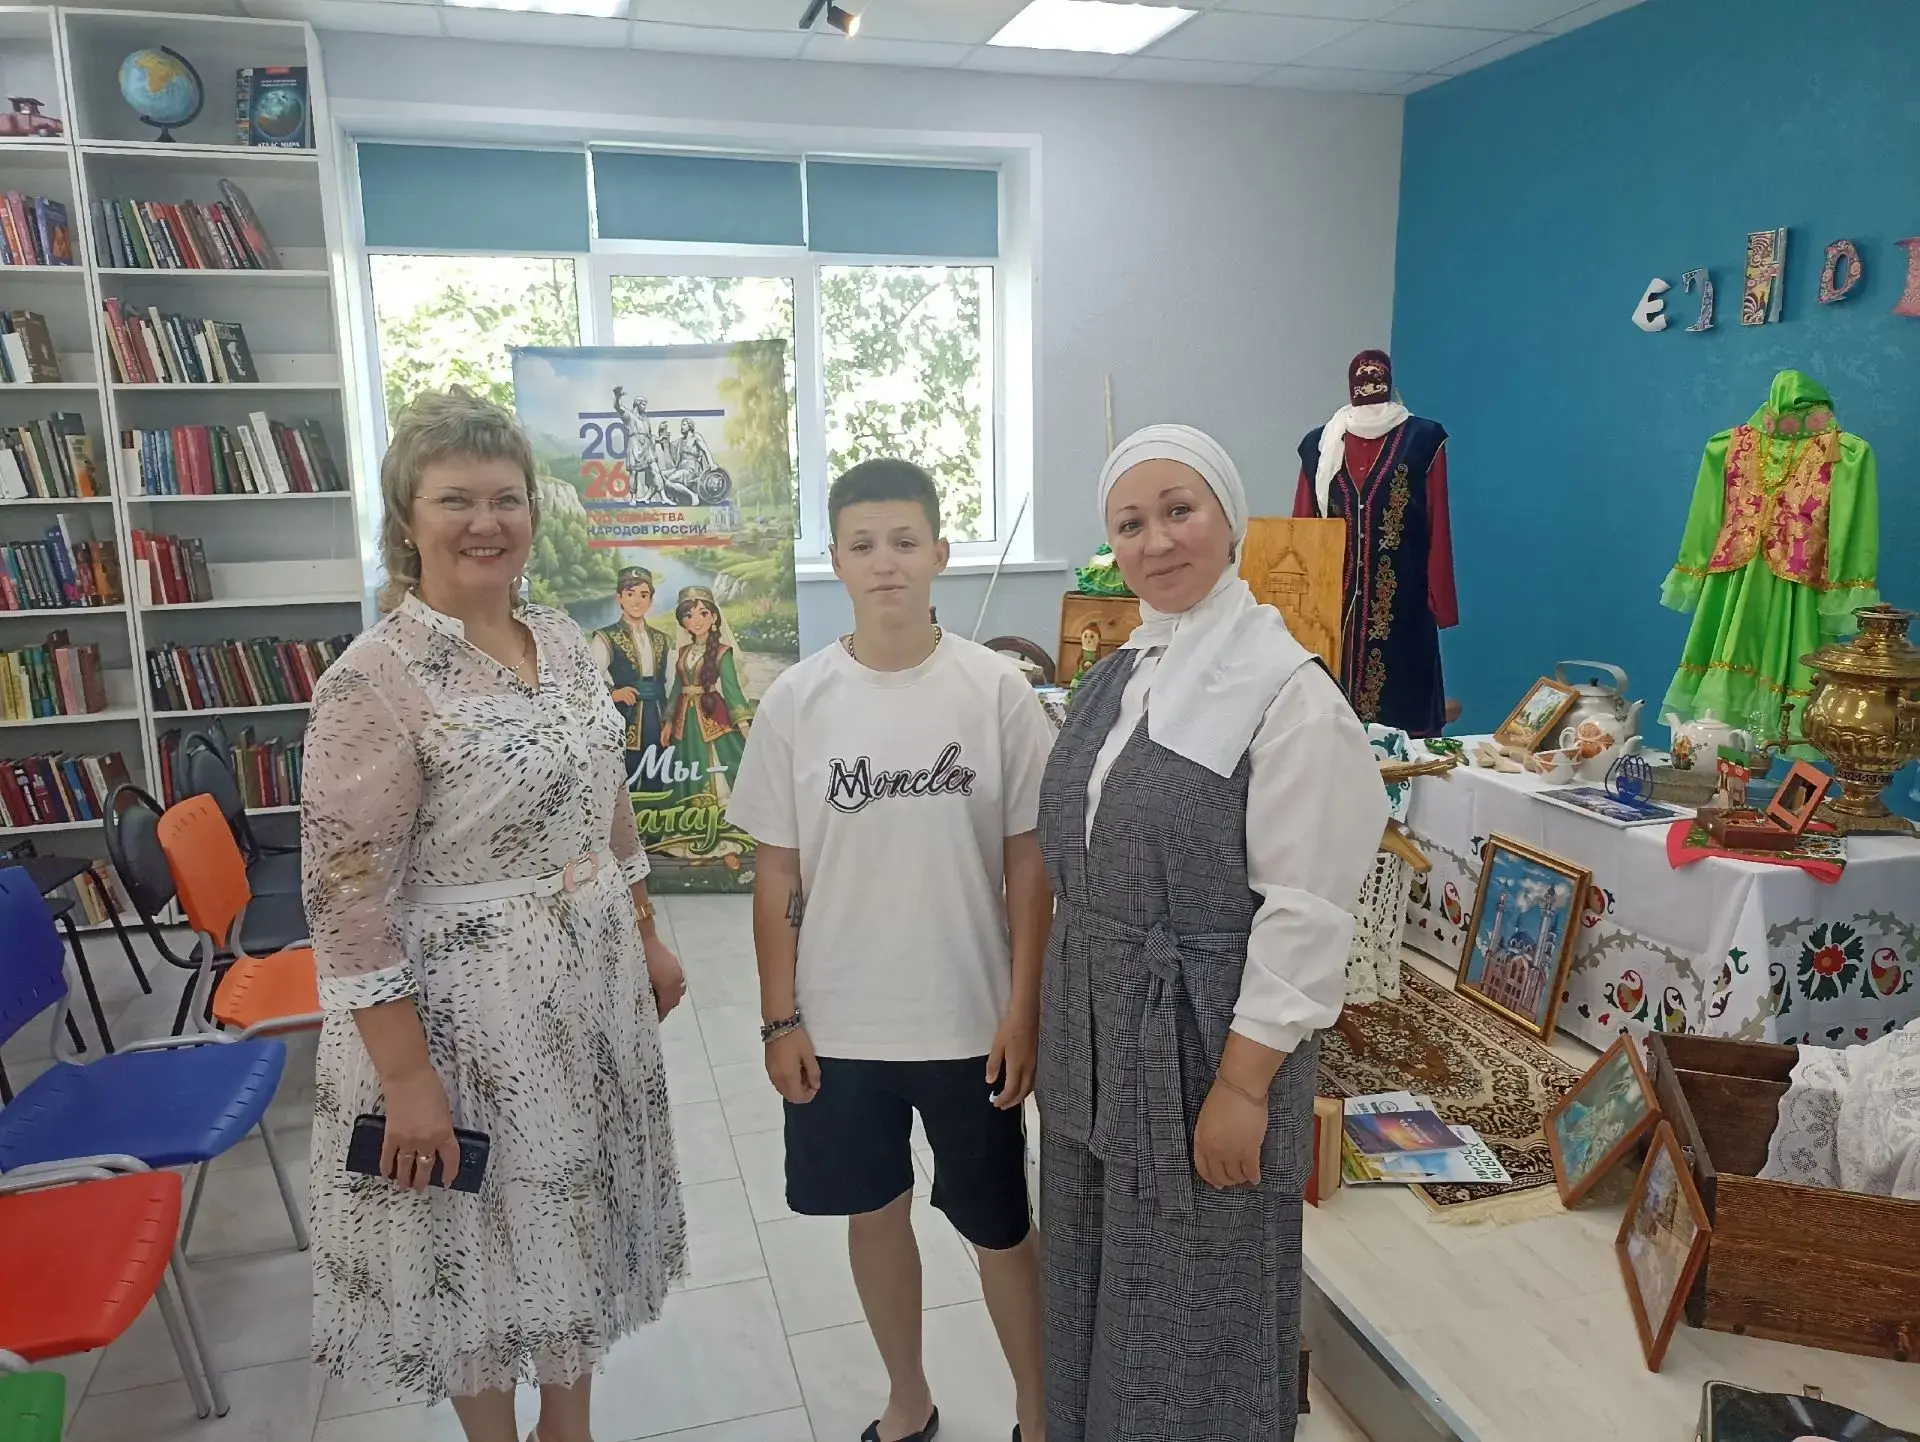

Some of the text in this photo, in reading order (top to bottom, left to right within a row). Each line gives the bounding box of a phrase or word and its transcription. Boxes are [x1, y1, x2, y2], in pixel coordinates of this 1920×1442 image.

[579, 422, 630, 460] 20
[580, 461, 630, 498] 26
[587, 524, 707, 536] НАРОДОВ РОССИИ
[627, 744, 703, 785] Мы
[825, 742, 976, 813] Moncler
